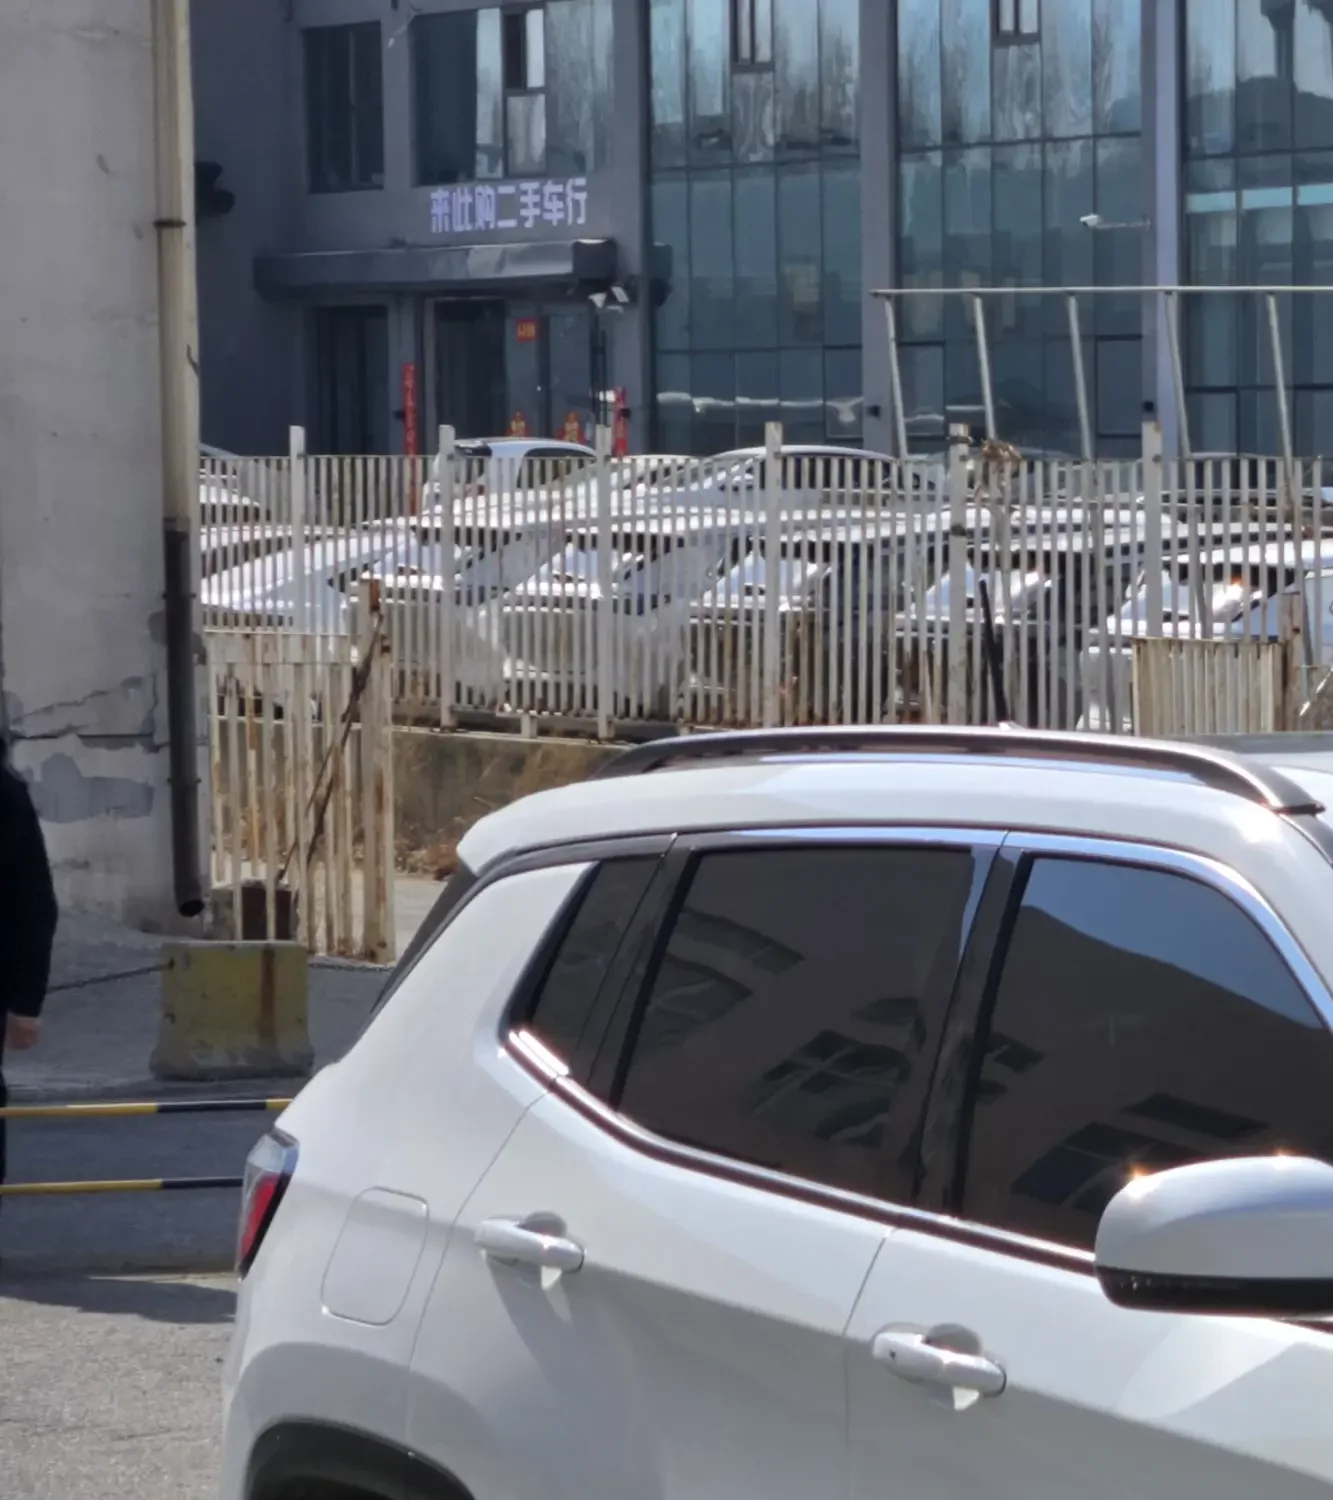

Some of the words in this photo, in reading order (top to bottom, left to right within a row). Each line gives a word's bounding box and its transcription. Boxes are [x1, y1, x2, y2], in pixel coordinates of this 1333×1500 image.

[430, 177, 588, 233] 来此购二手车行
